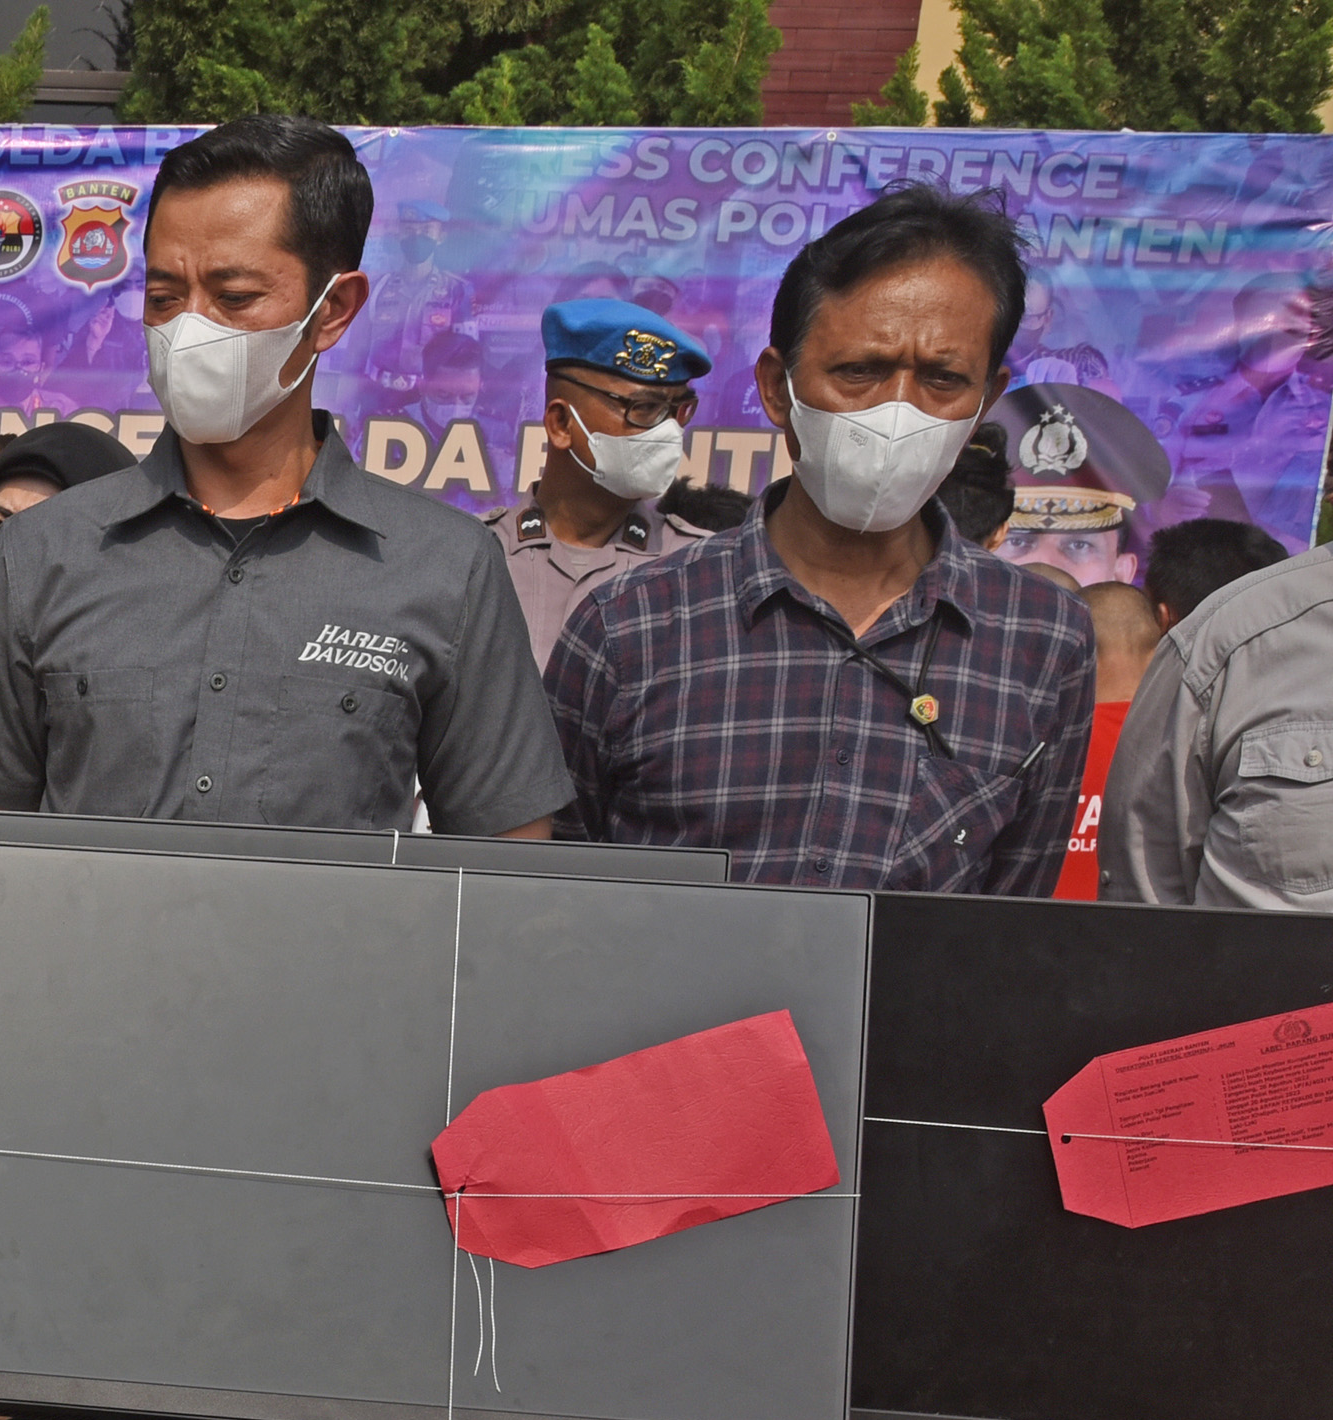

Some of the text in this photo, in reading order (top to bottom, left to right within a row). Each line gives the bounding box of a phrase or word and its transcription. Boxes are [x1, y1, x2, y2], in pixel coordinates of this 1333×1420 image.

[66, 183, 131, 200] BANTEN
[1, 244, 21, 252] POLRI
[1025, 216, 1226, 265] ANTEN
